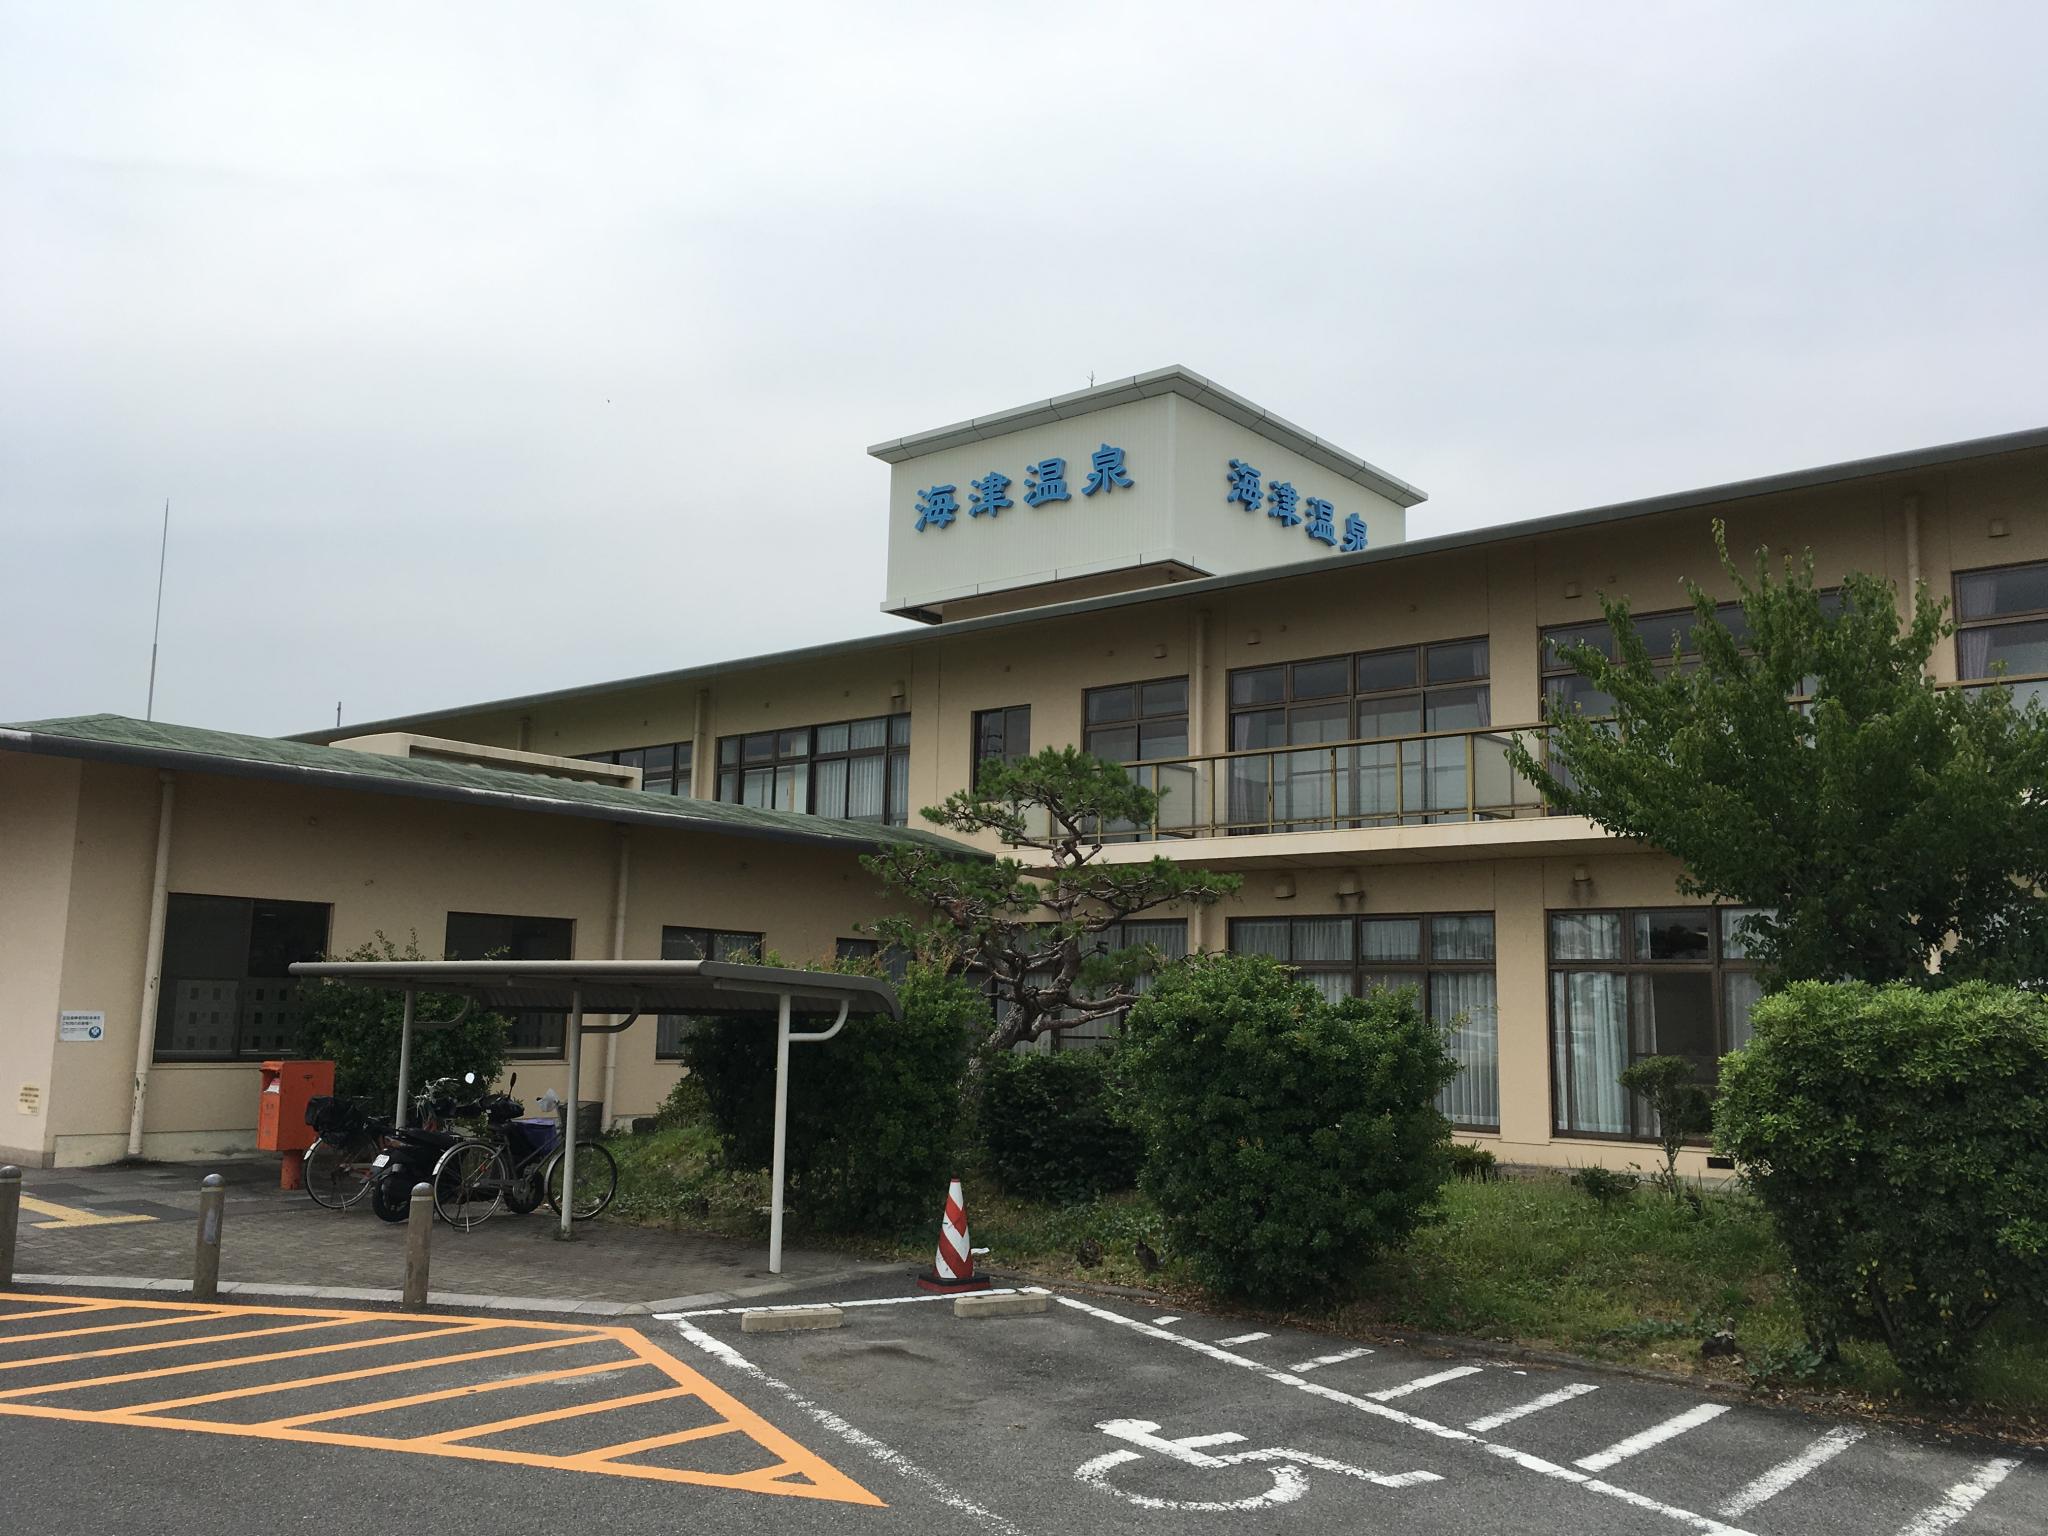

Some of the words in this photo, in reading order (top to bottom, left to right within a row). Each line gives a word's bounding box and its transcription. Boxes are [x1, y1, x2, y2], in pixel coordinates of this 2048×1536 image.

[914, 443, 1134, 532] 海津温泉
[1226, 459, 1369, 553] 海津温泉
